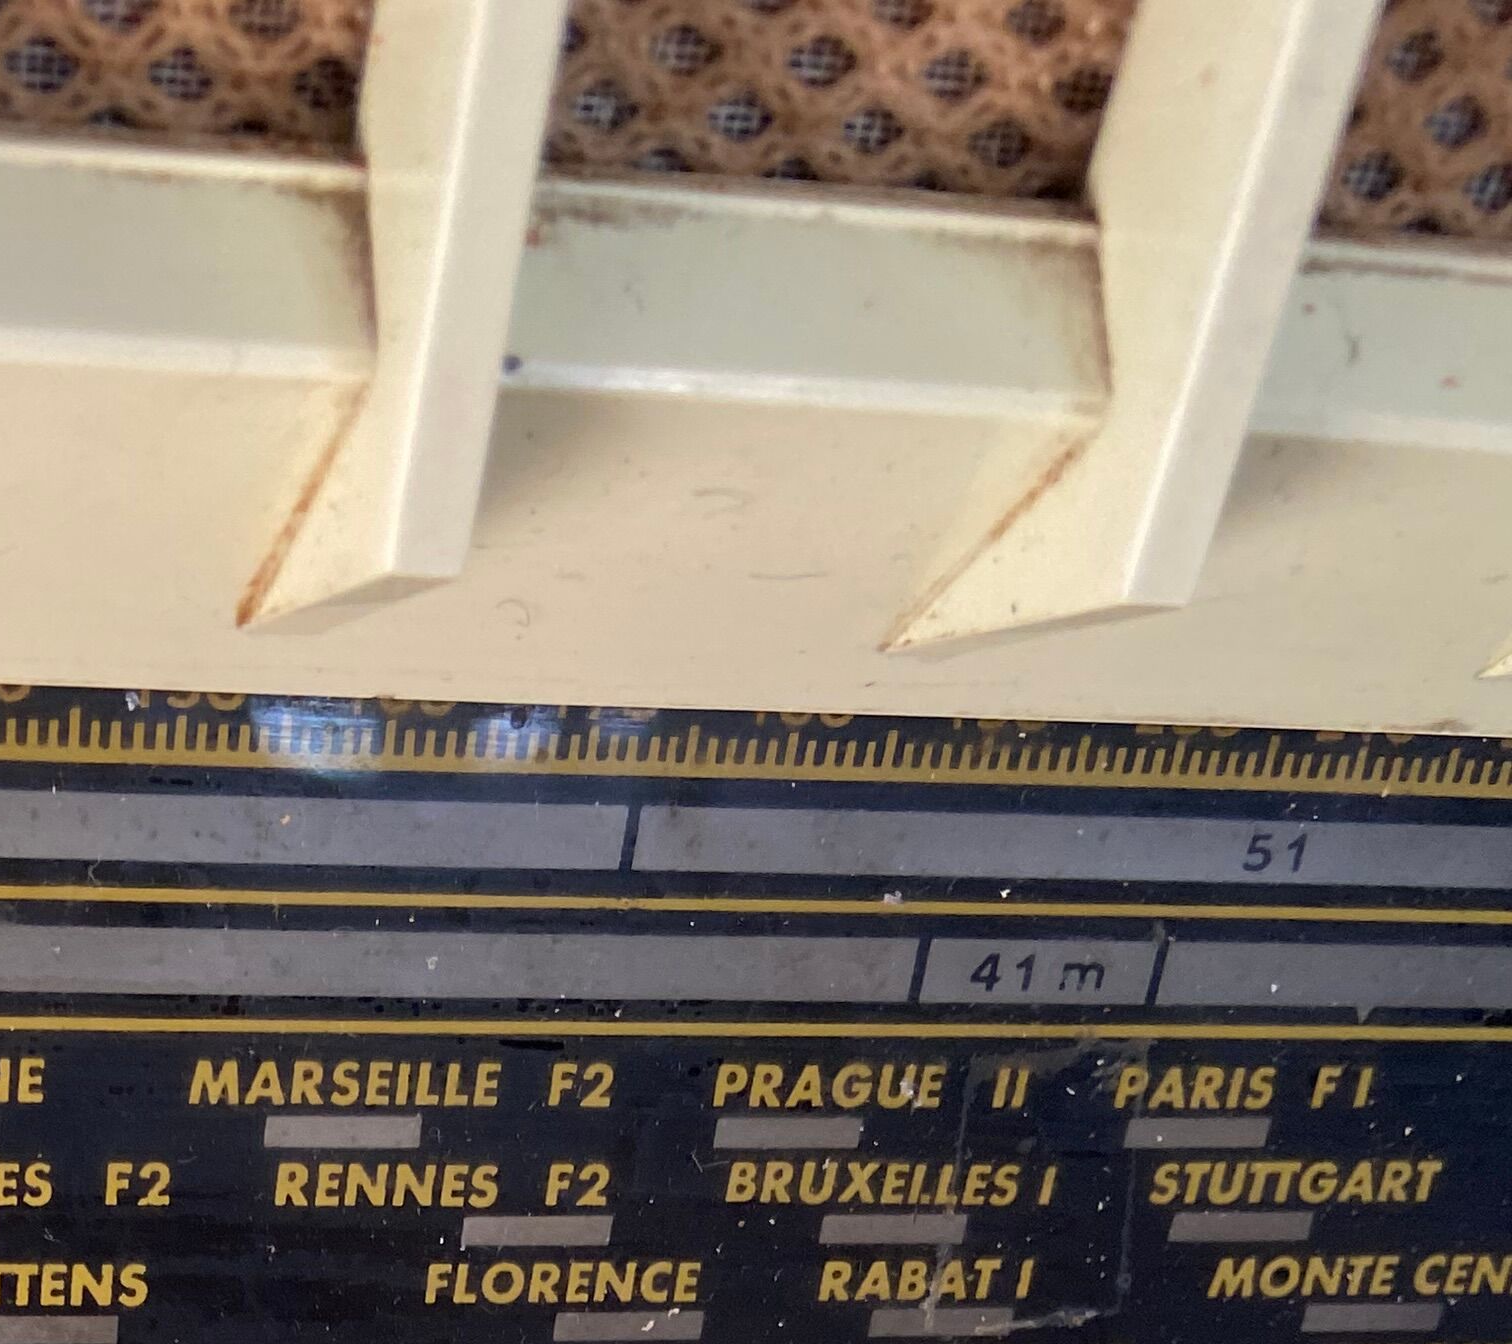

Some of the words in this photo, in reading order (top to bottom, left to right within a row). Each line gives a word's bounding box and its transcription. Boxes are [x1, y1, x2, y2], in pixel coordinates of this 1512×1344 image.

[1243, 833, 1308, 873] 51
[969, 954, 1035, 992] 41
[1057, 962, 1105, 992] m
[188, 1059, 502, 1107] MARSEILLE
[547, 1062, 615, 1108] F2
[712, 1063, 948, 1109] PRAGUE
[1113, 1066, 1277, 1111] PARIS
[105, 1162, 172, 1207] F2
[274, 1163, 500, 1208] RENNES
[544, 1163, 612, 1207] F2
[724, 1160, 1022, 1207] BRUXELLES
[1148, 1159, 1445, 1206] STUTTGART
[424, 1261, 702, 1305] FLORENCE
[818, 1258, 1002, 1302] RABAT
[1207, 1256, 1399, 1300] MONTE
